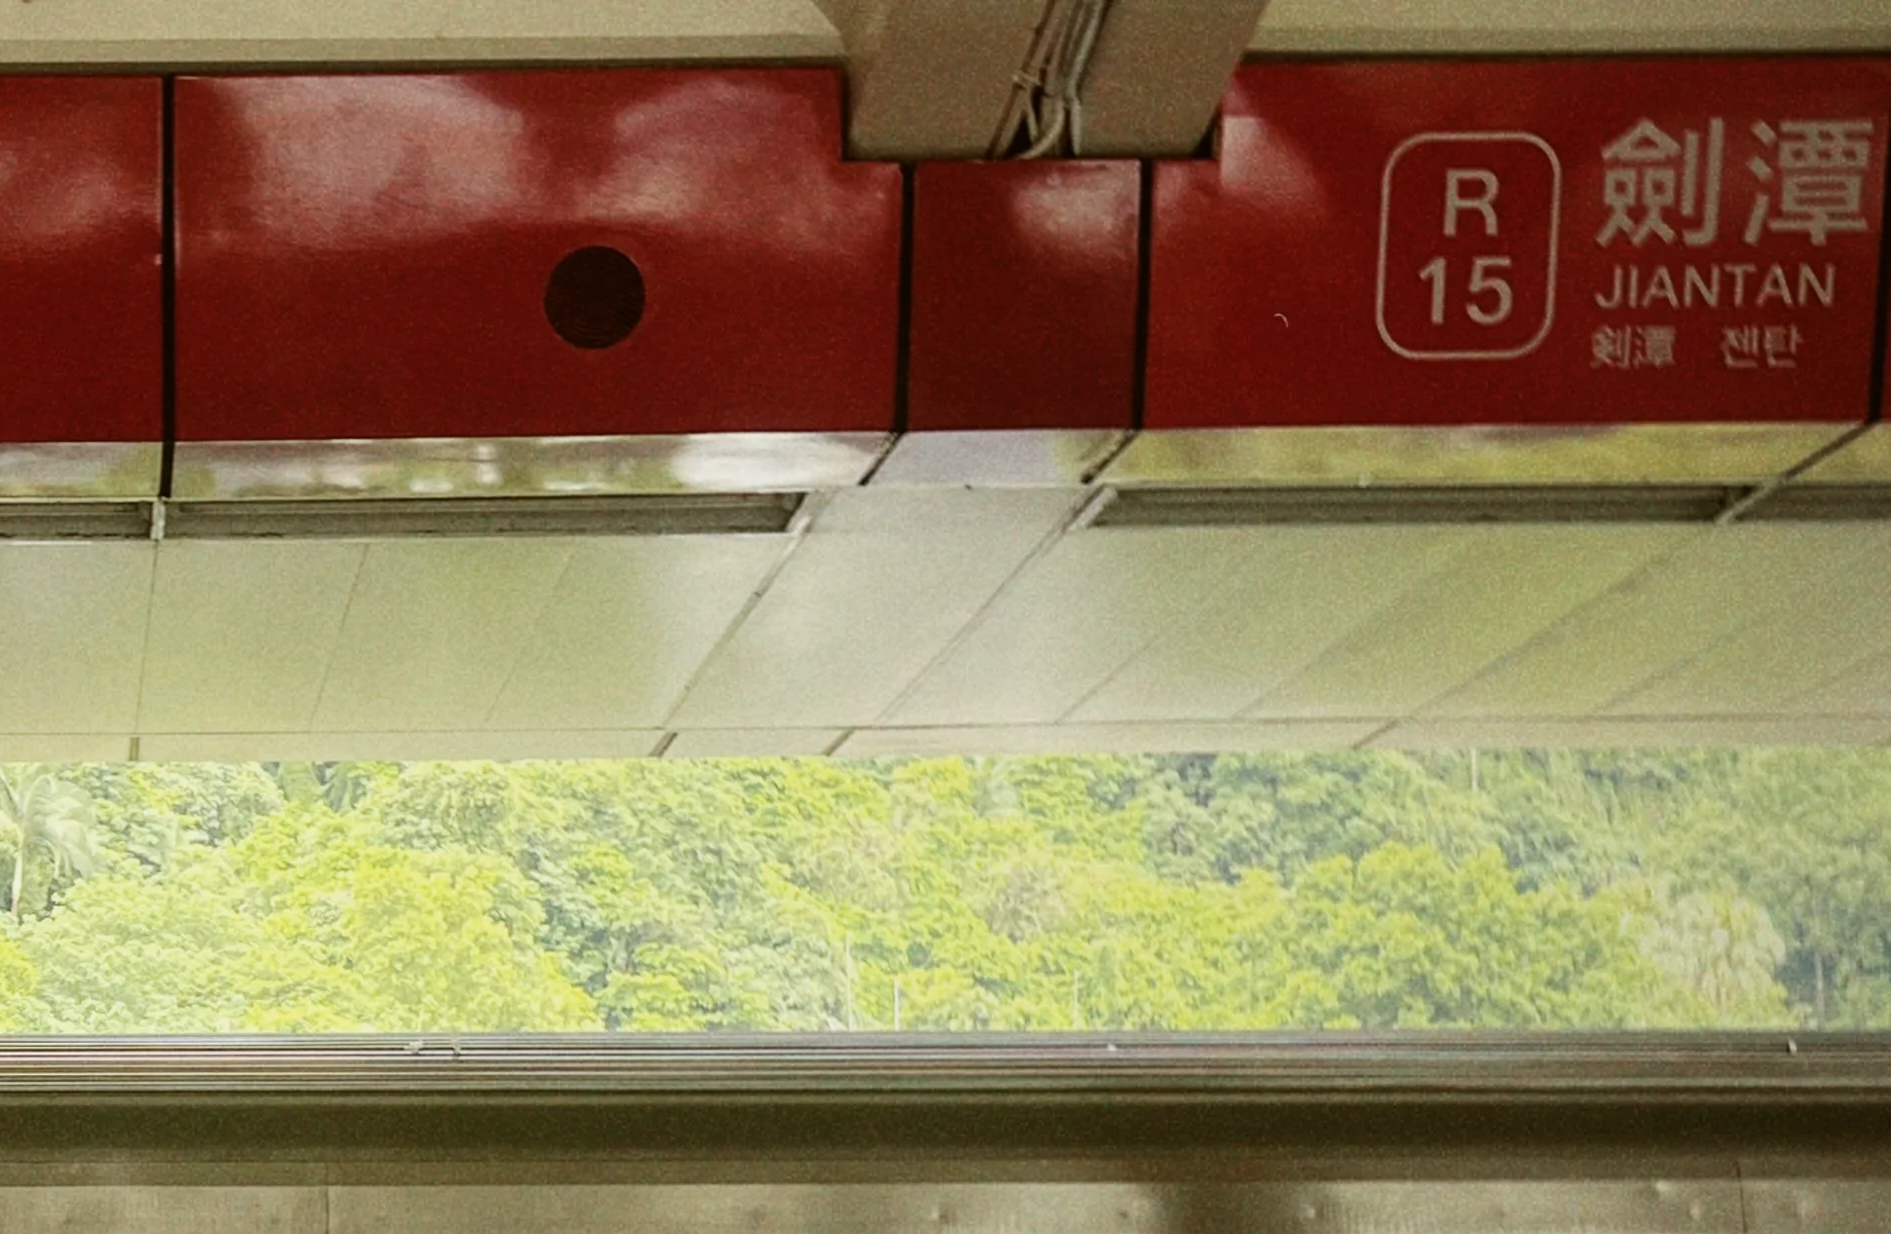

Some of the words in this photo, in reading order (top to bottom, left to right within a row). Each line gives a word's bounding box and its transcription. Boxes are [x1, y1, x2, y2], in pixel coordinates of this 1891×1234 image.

[1442, 167, 1500, 238] R
[1594, 116, 1875, 248] 劍潭
[1417, 255, 1514, 326] 15
[1594, 263, 1838, 311] JIANTAN
